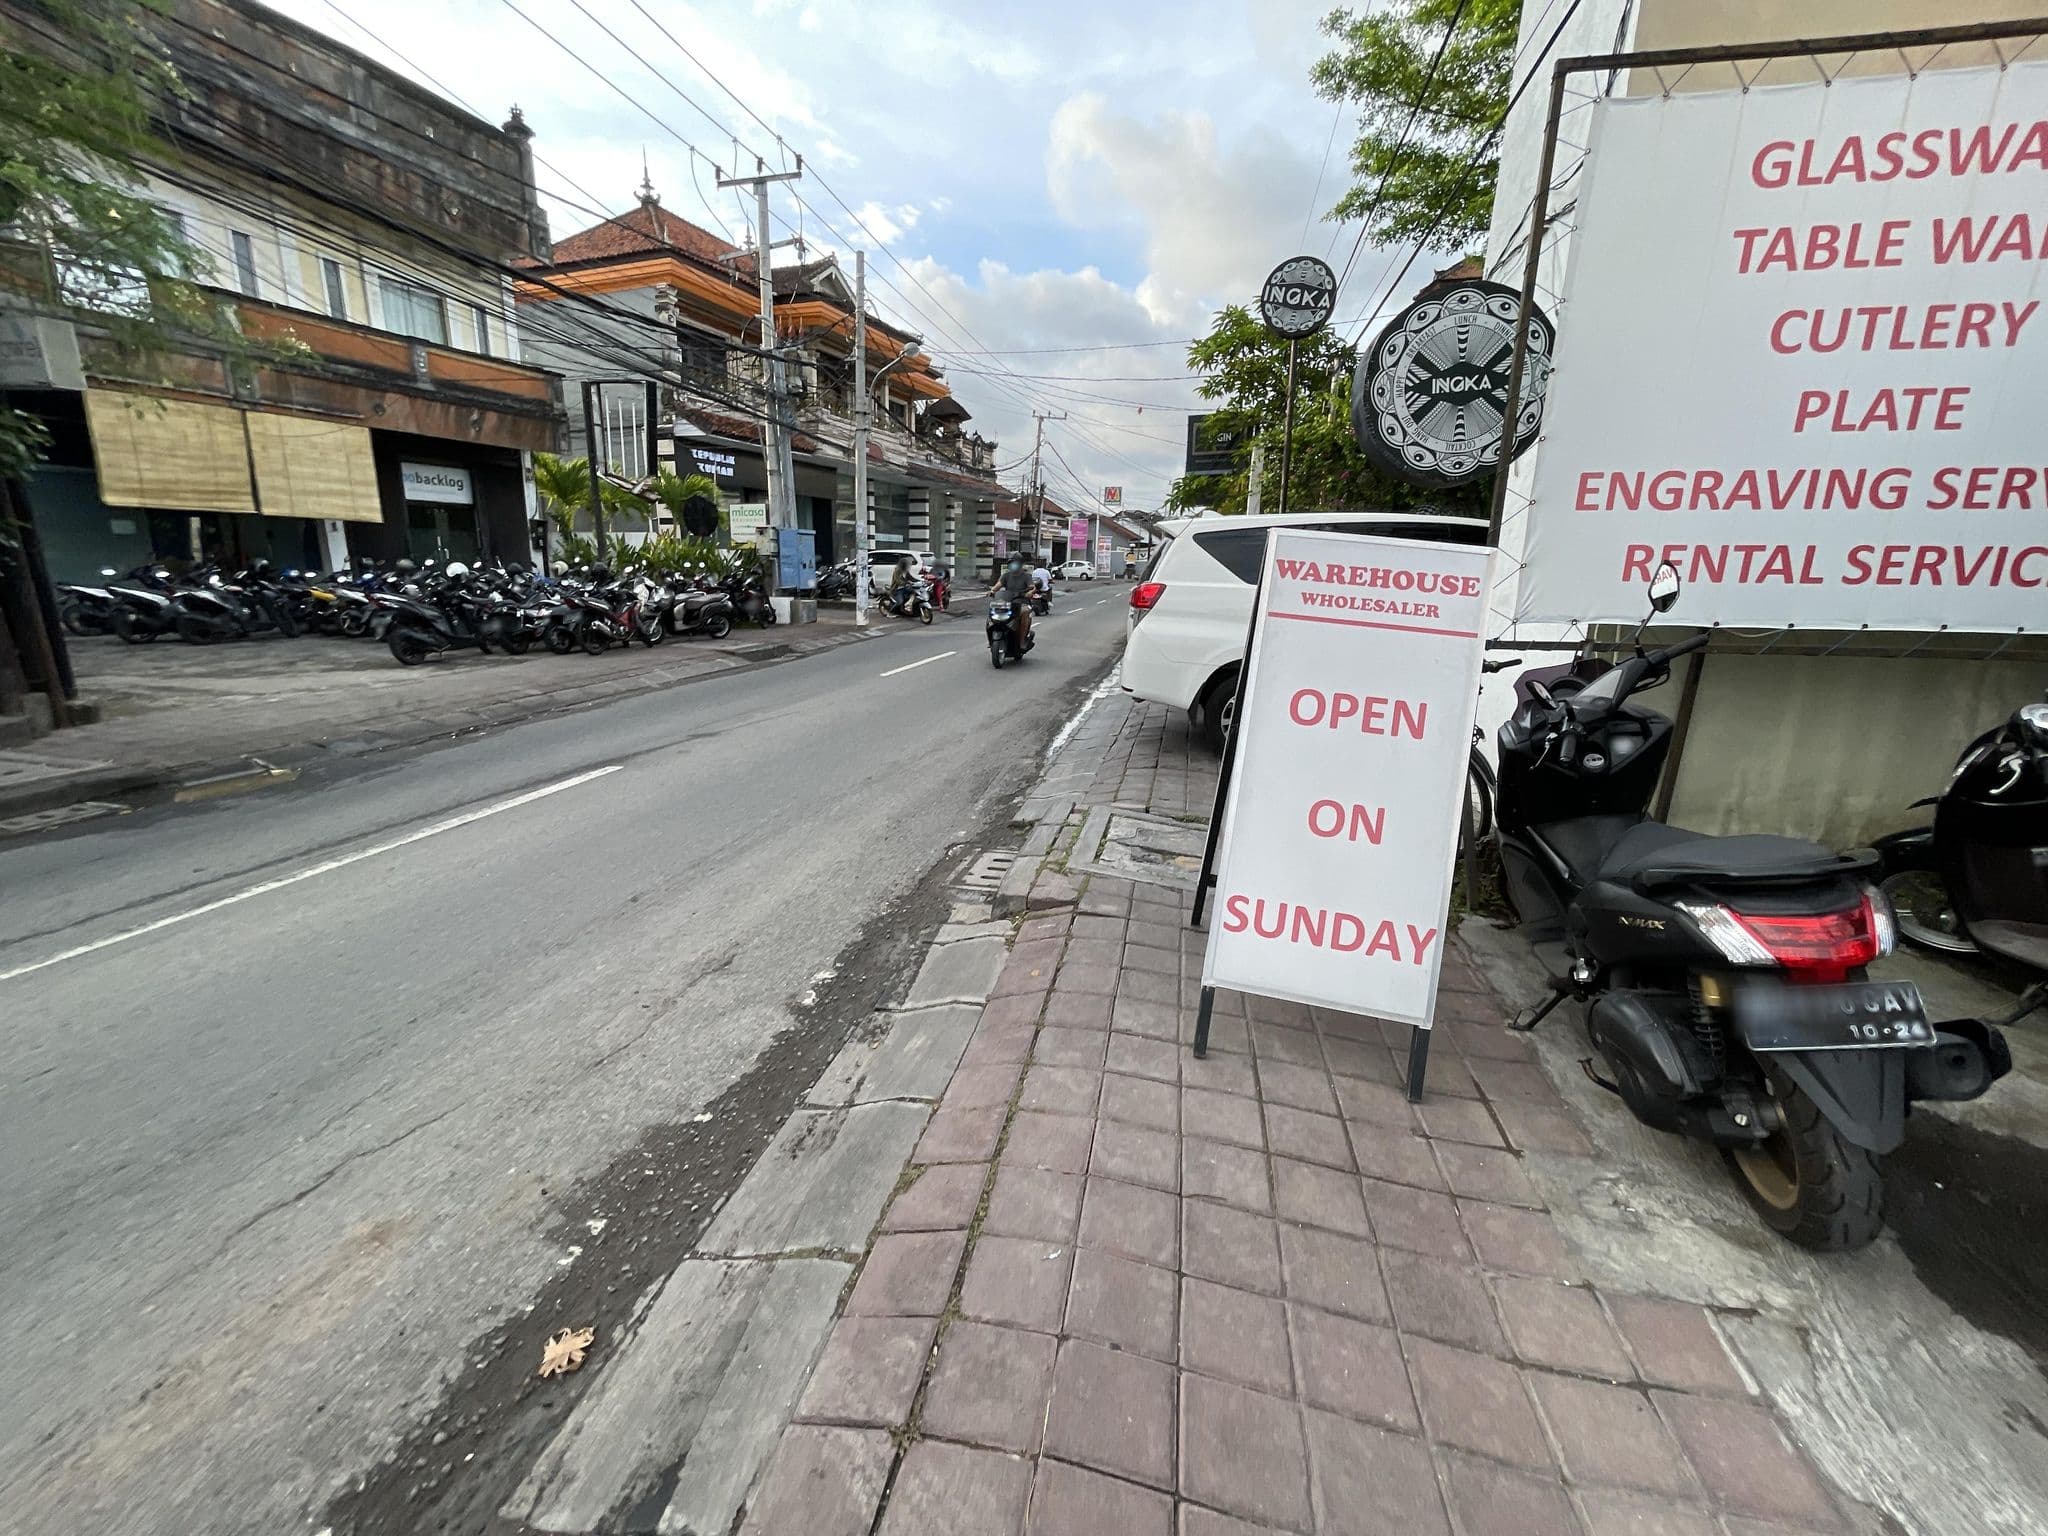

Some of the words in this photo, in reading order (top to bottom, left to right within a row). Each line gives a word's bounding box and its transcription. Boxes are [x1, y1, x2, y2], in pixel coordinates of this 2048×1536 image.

[1733, 220, 1911, 273] TABLE
[1932, 213, 2048, 264] WA
[1263, 285, 1331, 308] INGKA
[1454, 315, 1477, 325] LUNCH
[1769, 300, 2040, 354] CUTLERY
[1406, 326, 1437, 358] BREAKFAST
[1394, 376, 1405, 398] HAPPY
[1431, 374, 1492, 395] INGKA
[1793, 387, 1970, 433] PLATE
[1445, 440, 1476, 451] COCKTAIL
[1574, 467, 1913, 511] ENGRAVING
[1926, 467, 2048, 510] SER
[731, 506, 764, 516] micasa
[1276, 559, 1481, 597] WAREHOUSE
[1621, 544, 1825, 585] RENTAL
[1841, 545, 2048, 588] SERVIC
[1300, 592, 1440, 619] WHOLESALER
[1289, 688, 1428, 740] OPEN
[1308, 799, 1386, 845] ON
[1222, 894, 1437, 966] SUNDAY
